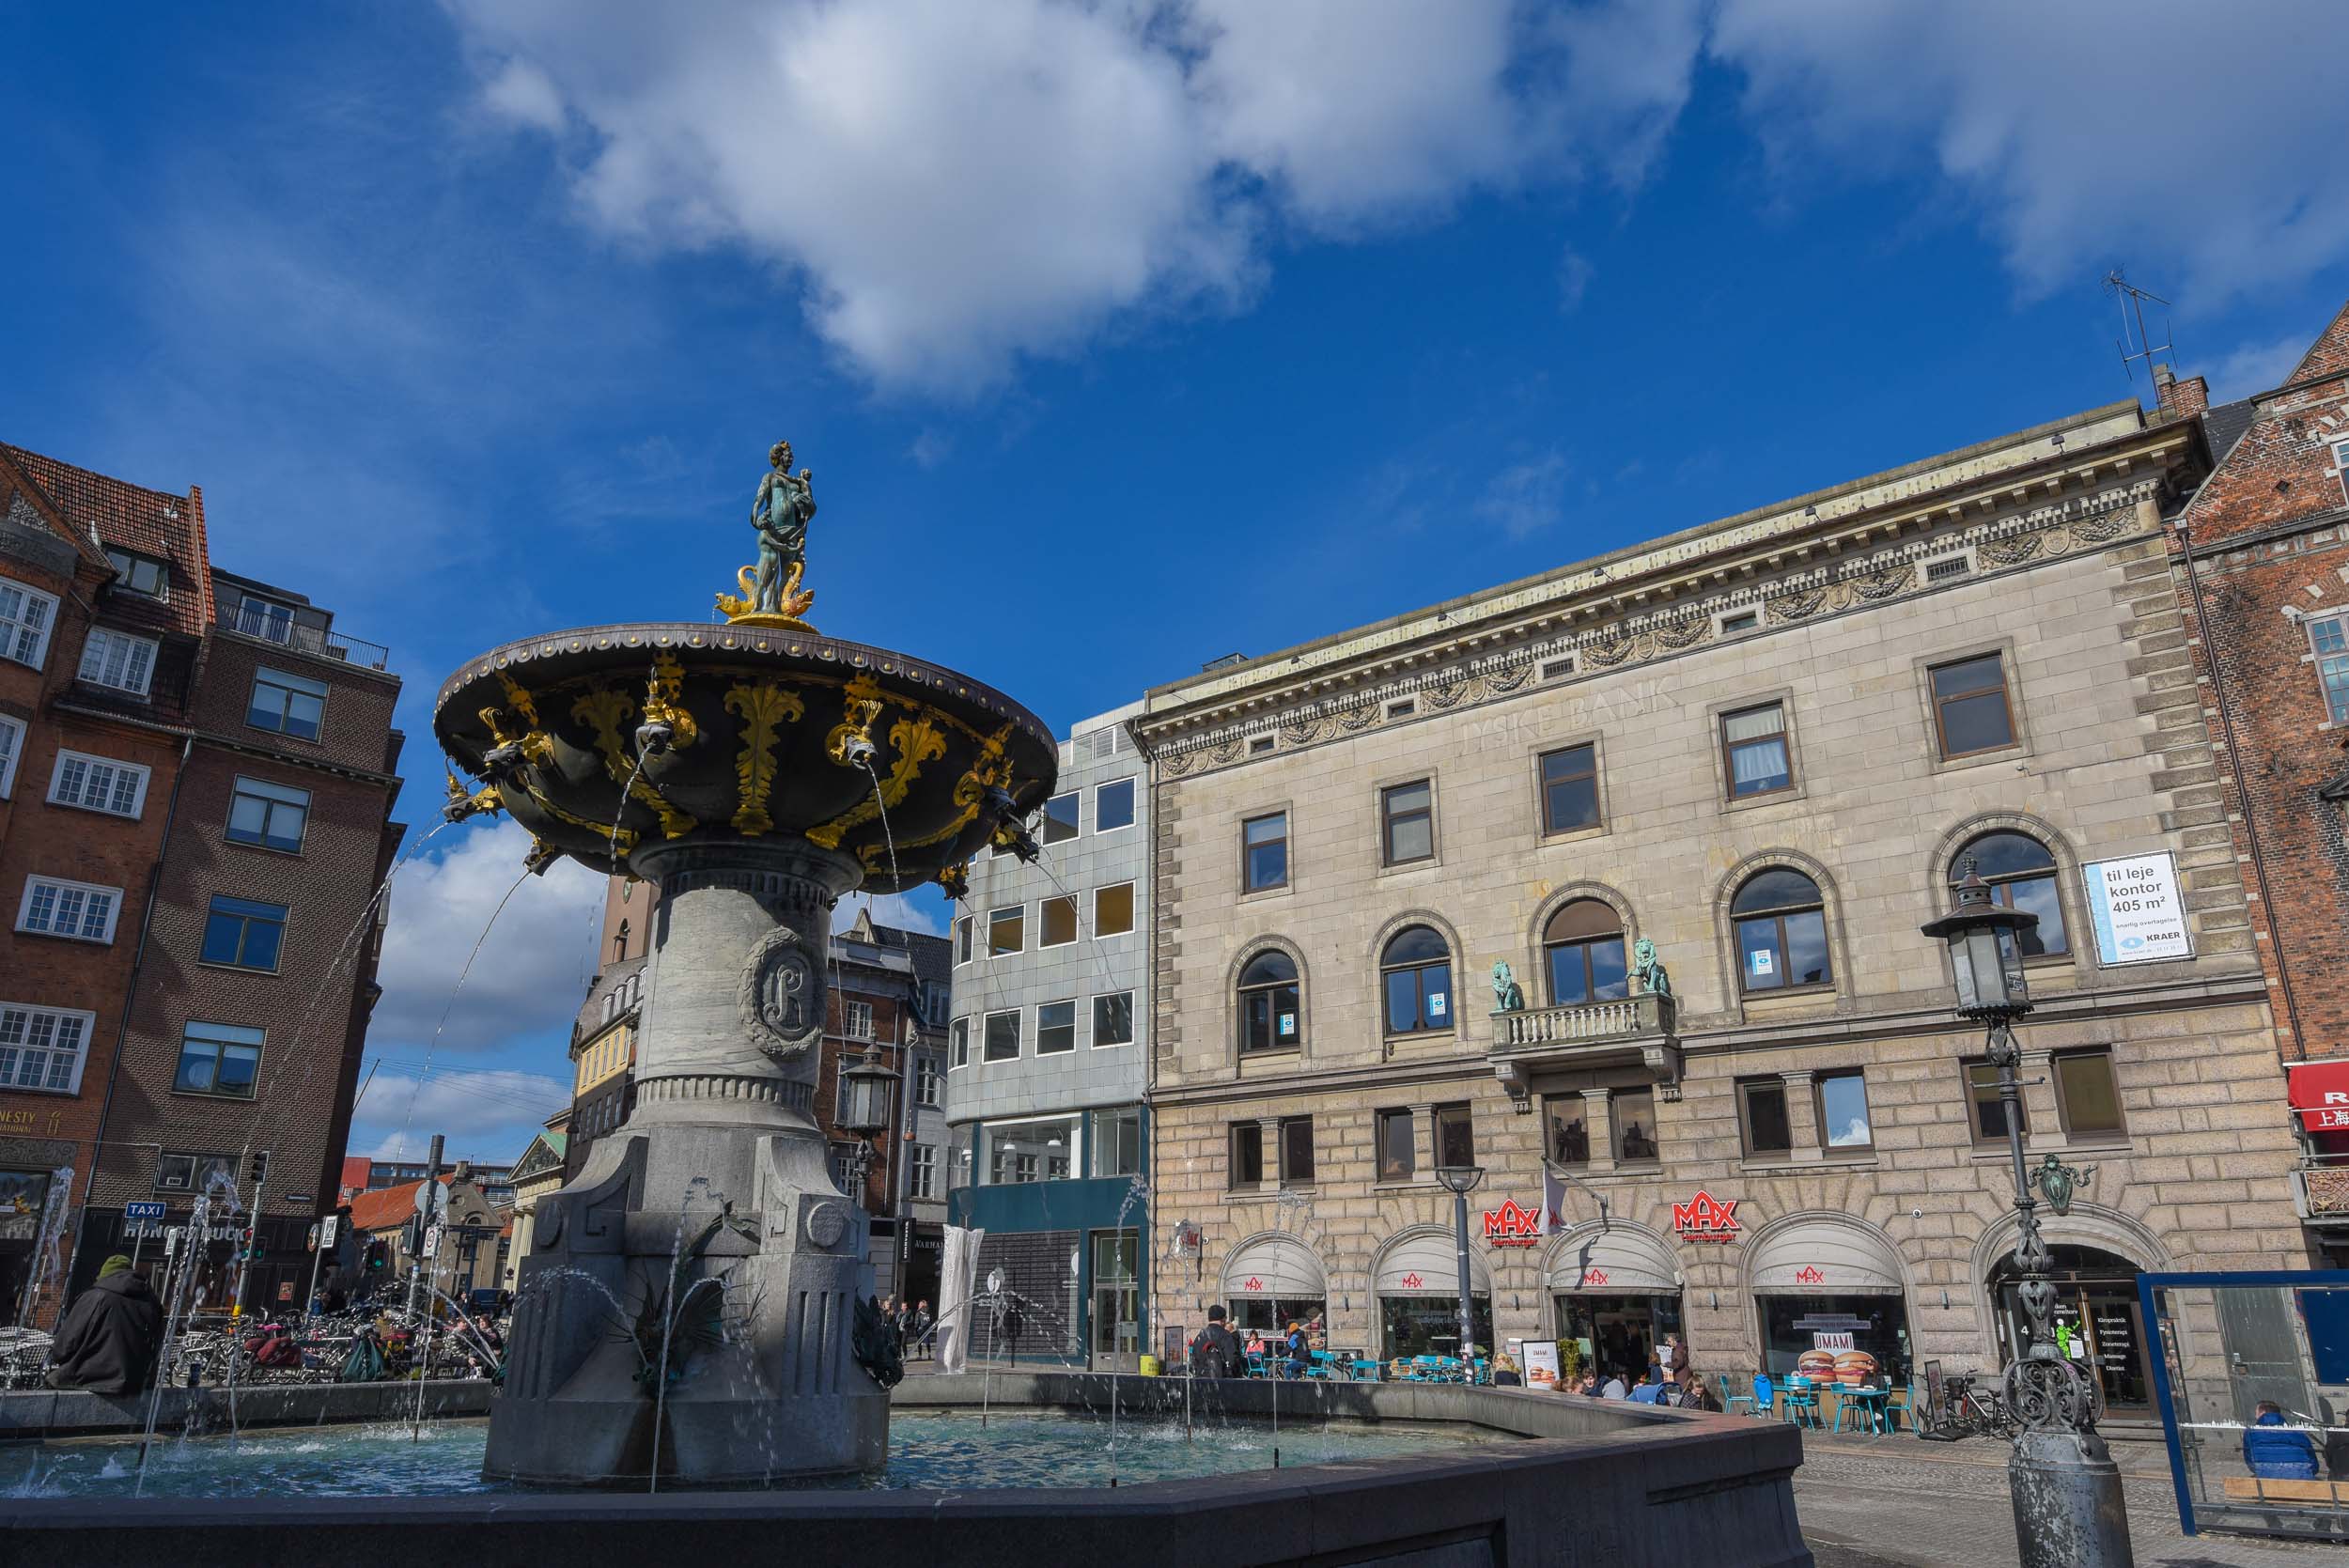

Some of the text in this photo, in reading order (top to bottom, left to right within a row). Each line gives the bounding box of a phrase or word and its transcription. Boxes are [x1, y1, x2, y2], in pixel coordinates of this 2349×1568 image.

[1569, 677, 1679, 726] BANK
[2107, 867, 2155, 882] til leje
[2109, 882, 2163, 898] kontor
[2113, 899, 2140, 913] 405
[2146, 931, 2181, 942] KRAER
[131, 1204, 161, 1216] TAXI
[1484, 1199, 1540, 1236] MAX
[1672, 1190, 1740, 1231] MAX
[1402, 1272, 1423, 1288] MAX
[1583, 1268, 1609, 1285] MAX
[1796, 1265, 1825, 1284] MAX
[1244, 1277, 1263, 1291] MAX
[2021, 1325, 2030, 1335] 4
[1814, 1334, 1854, 1350] UMAMI
